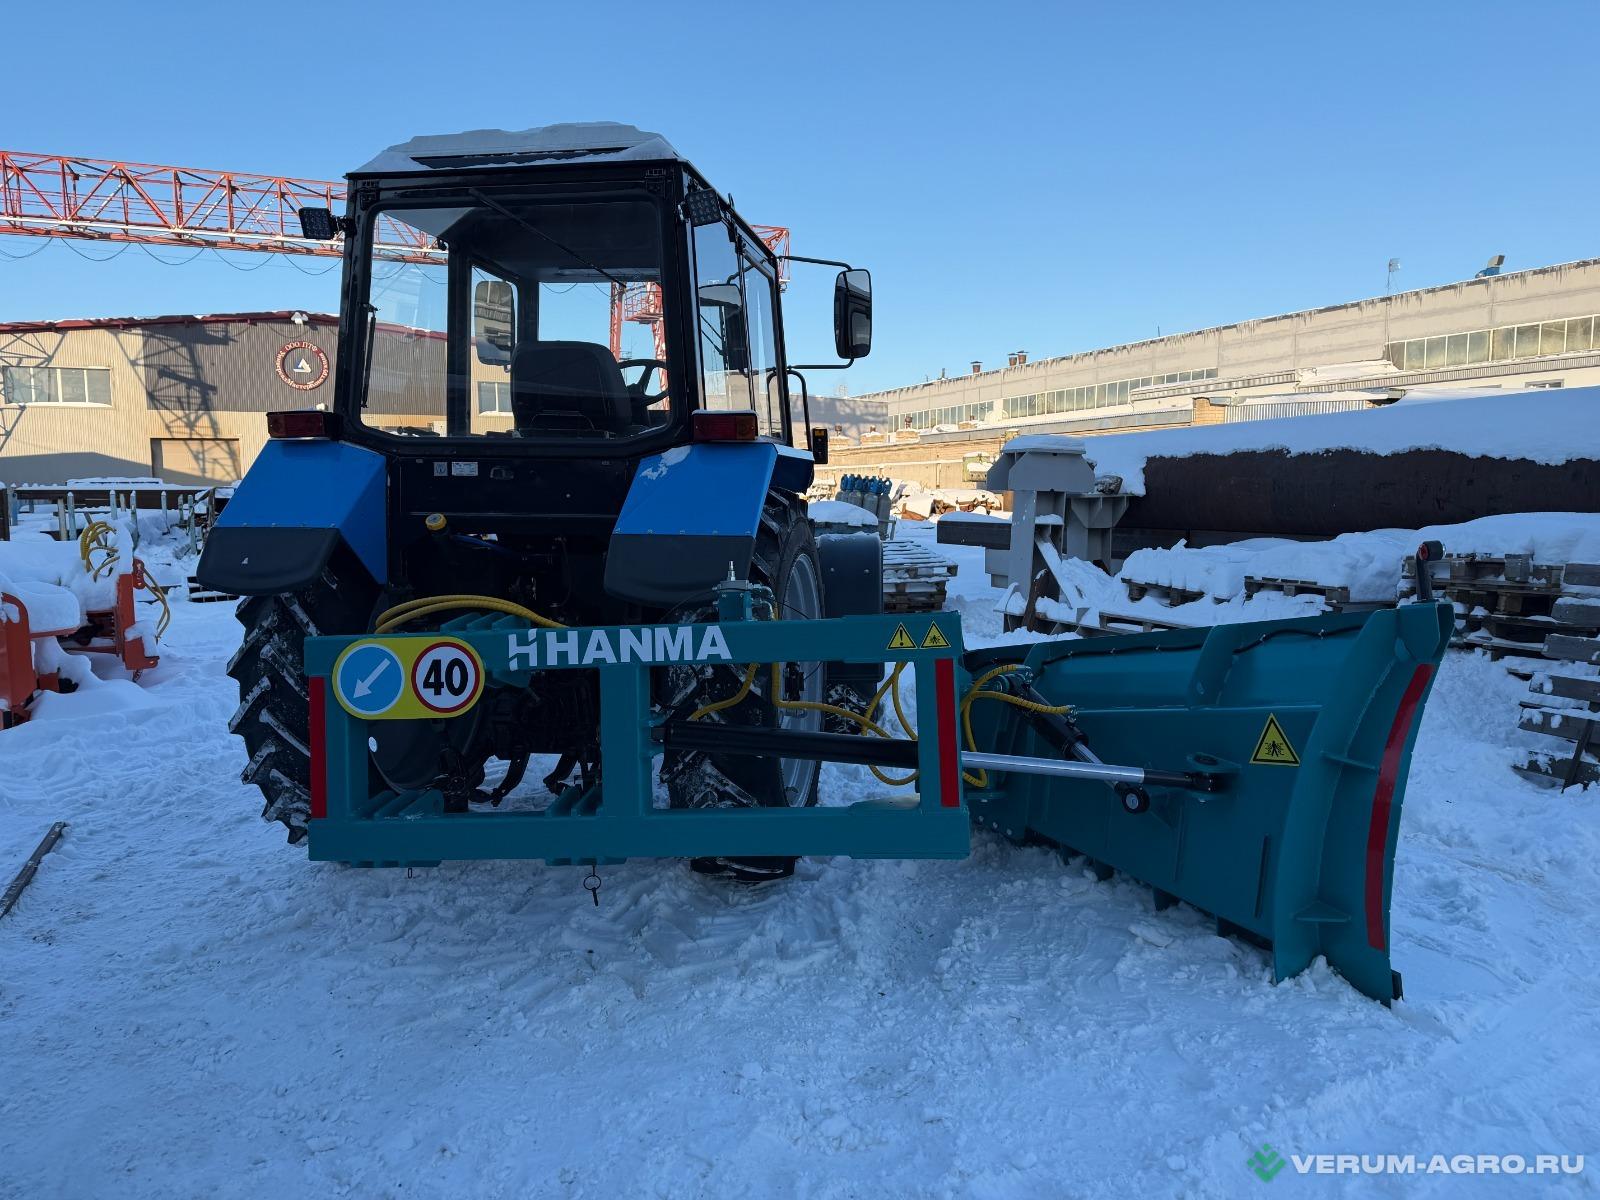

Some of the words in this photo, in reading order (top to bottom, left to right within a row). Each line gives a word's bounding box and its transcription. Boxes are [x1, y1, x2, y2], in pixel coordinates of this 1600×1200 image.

[285, 342, 300, 351] ООО
[302, 341, 318, 352] ПТФ
[546, 625, 733, 666] HANMA
[423, 657, 469, 697] 40
